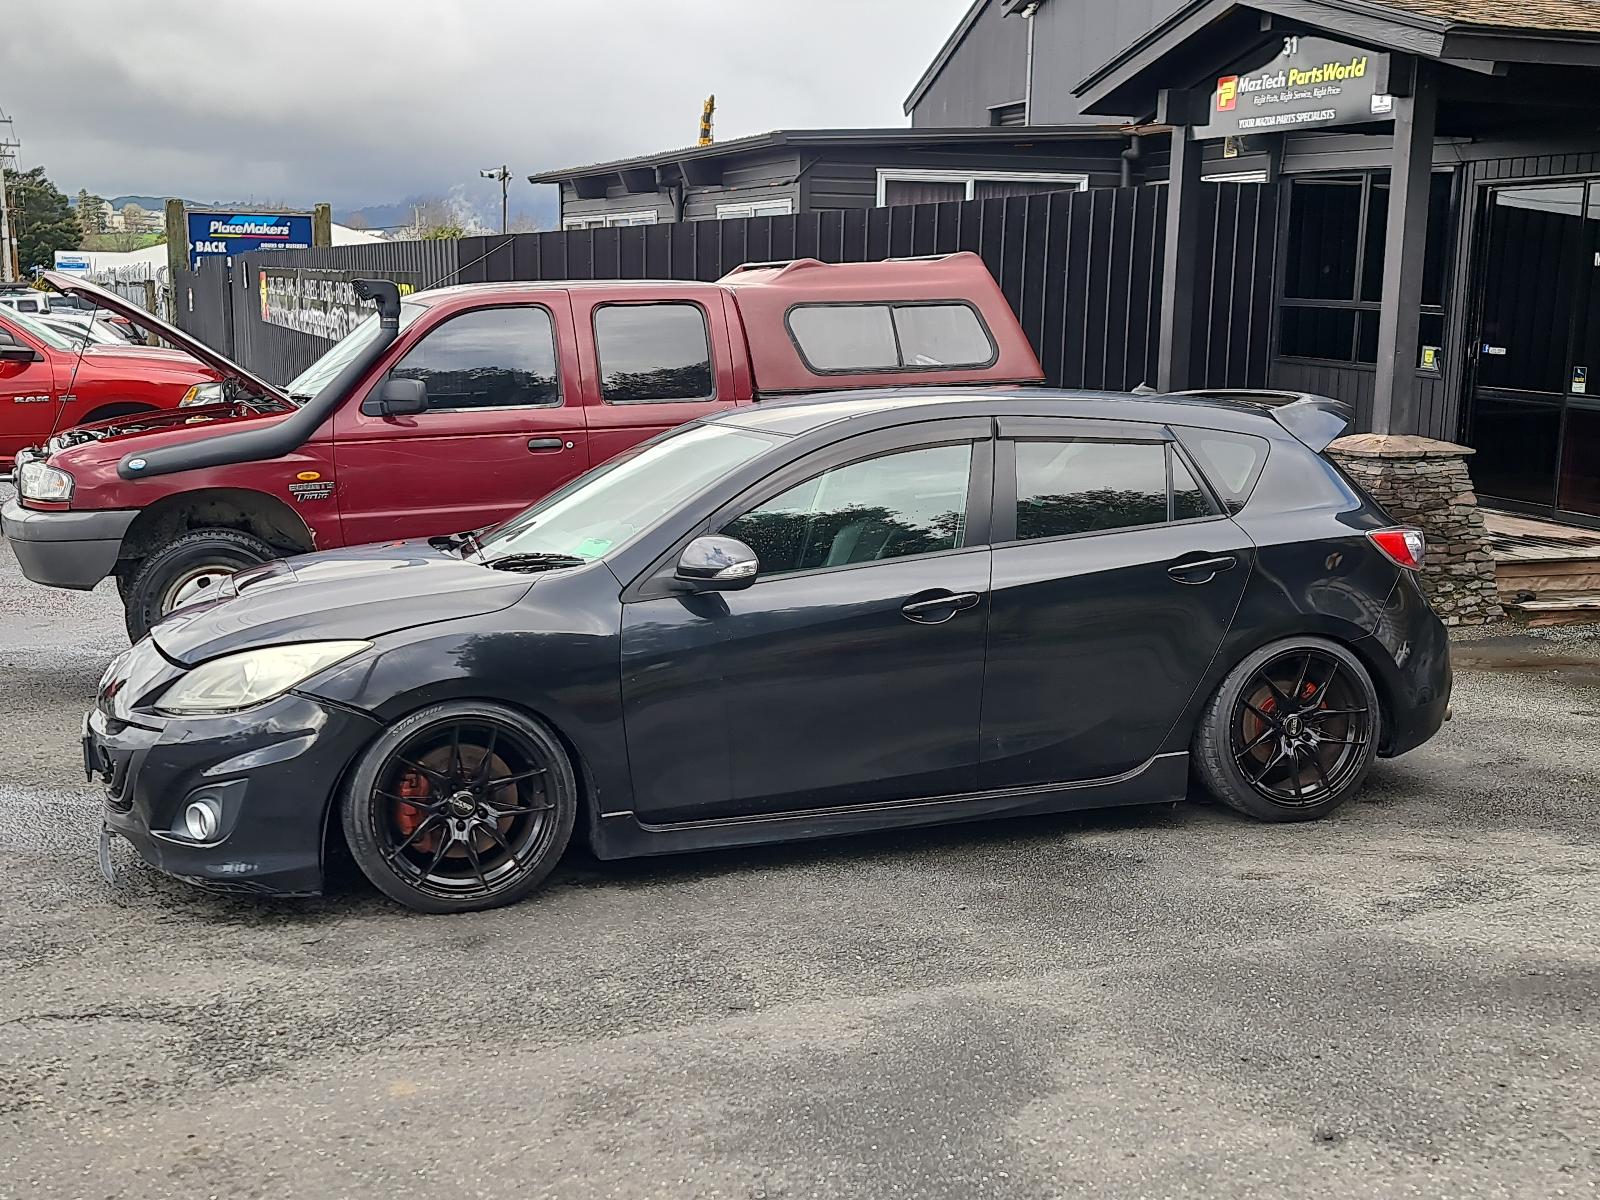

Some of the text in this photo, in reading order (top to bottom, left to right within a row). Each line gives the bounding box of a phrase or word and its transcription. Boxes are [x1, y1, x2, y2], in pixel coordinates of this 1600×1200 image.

[1283, 36, 1298, 55] 31
[1237, 57, 1368, 93] MazTech PartsWorld
[1239, 109, 1336, 128] YOUR MAZDA PARTS SPECIALISTS
[209, 221, 289, 235] PlaceMakers
[195, 241, 227, 252] BACK
